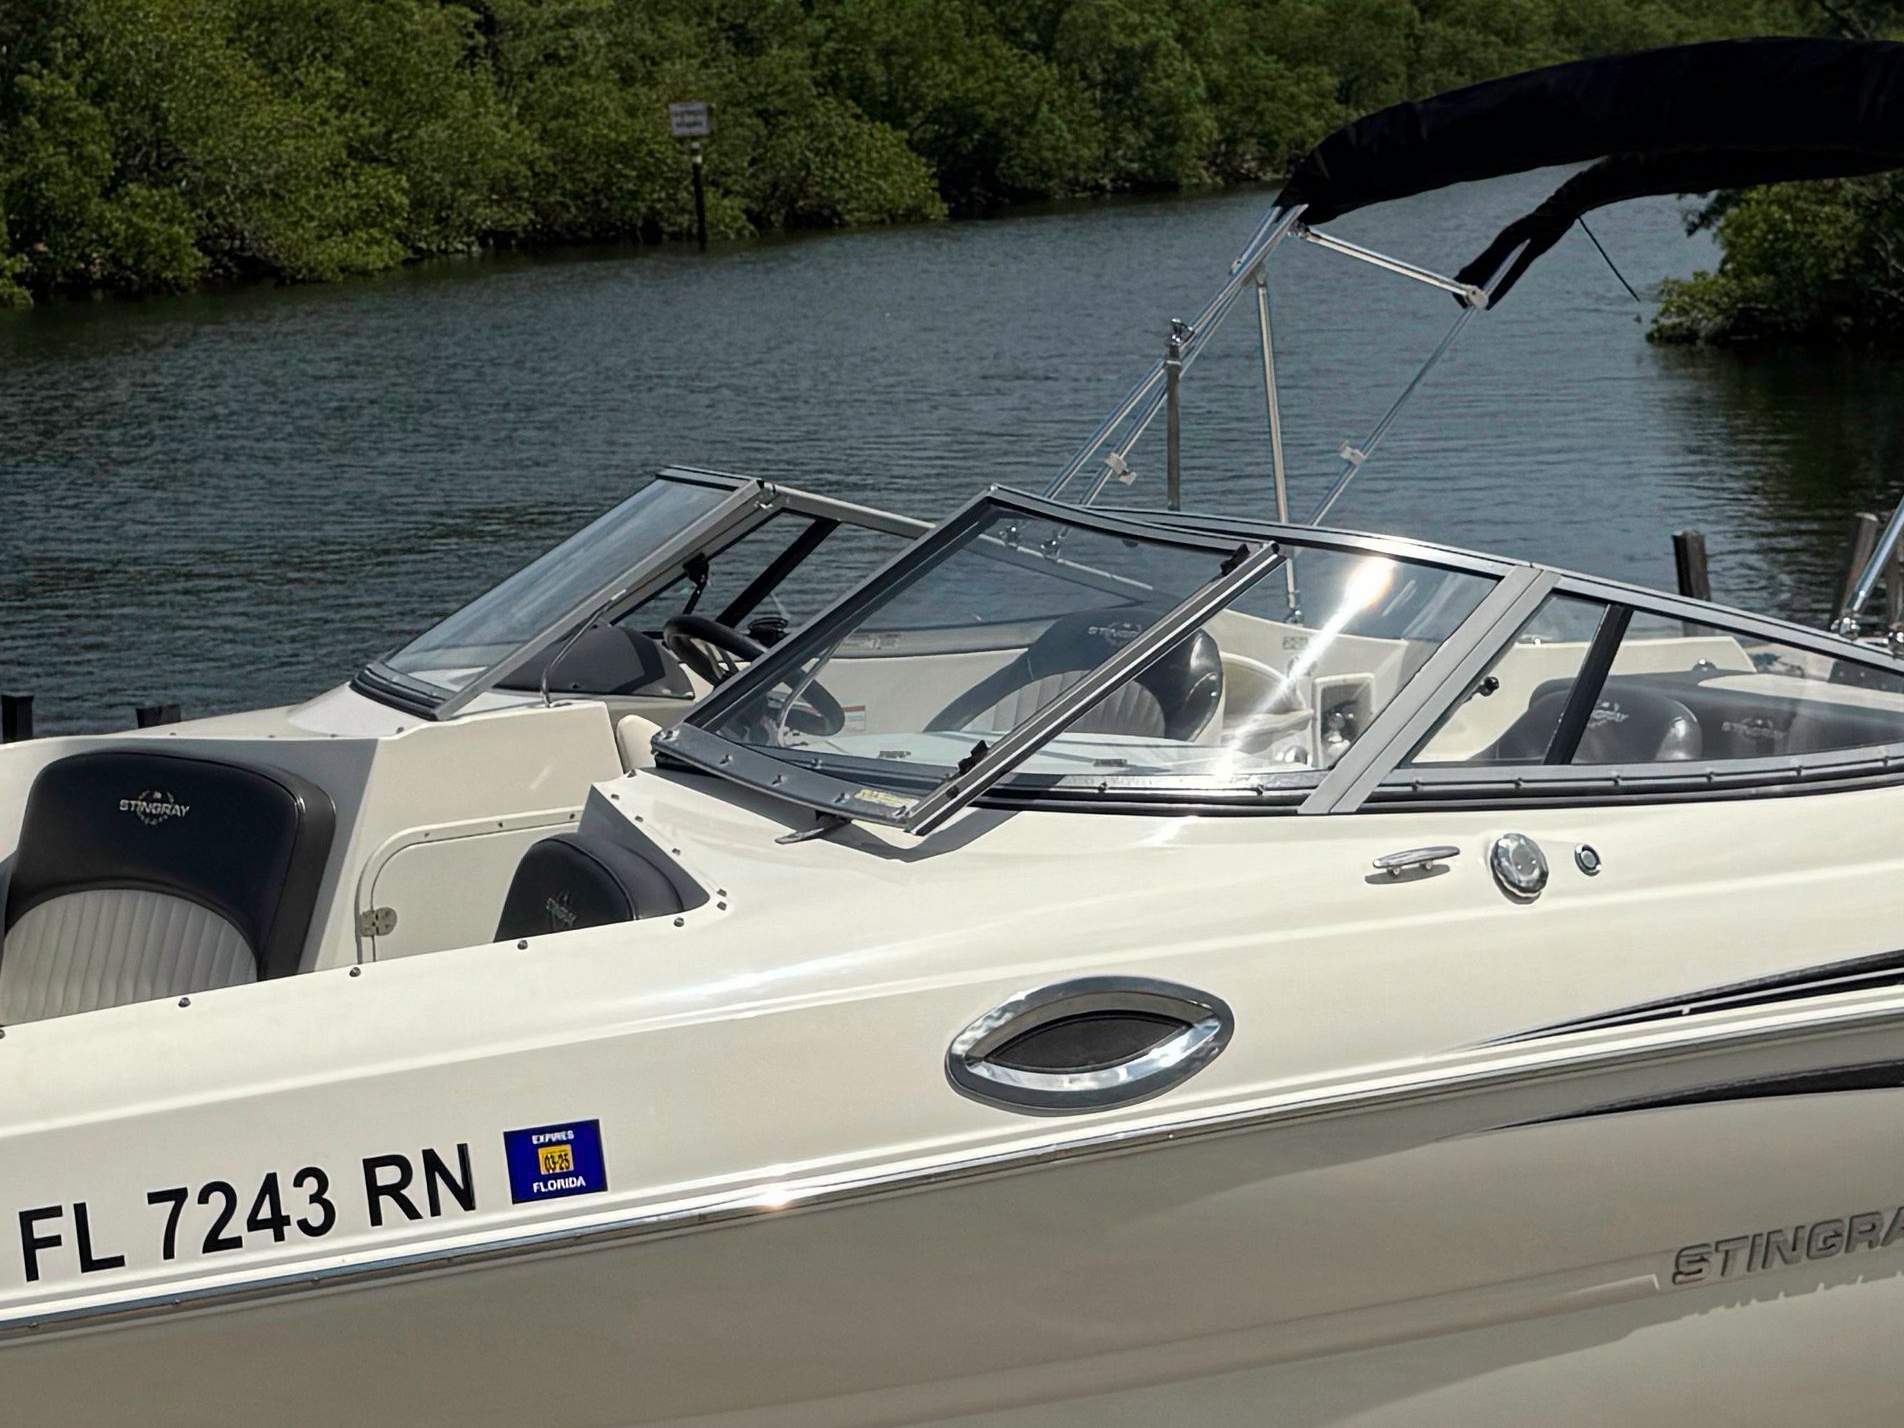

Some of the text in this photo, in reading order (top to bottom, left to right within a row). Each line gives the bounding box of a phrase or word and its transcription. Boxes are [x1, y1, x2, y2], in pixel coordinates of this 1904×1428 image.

[119, 799, 190, 817] STINGRAY
[532, 1176, 586, 1193] FLORIDA
[18, 1143, 476, 1282] FL 7243 RN
